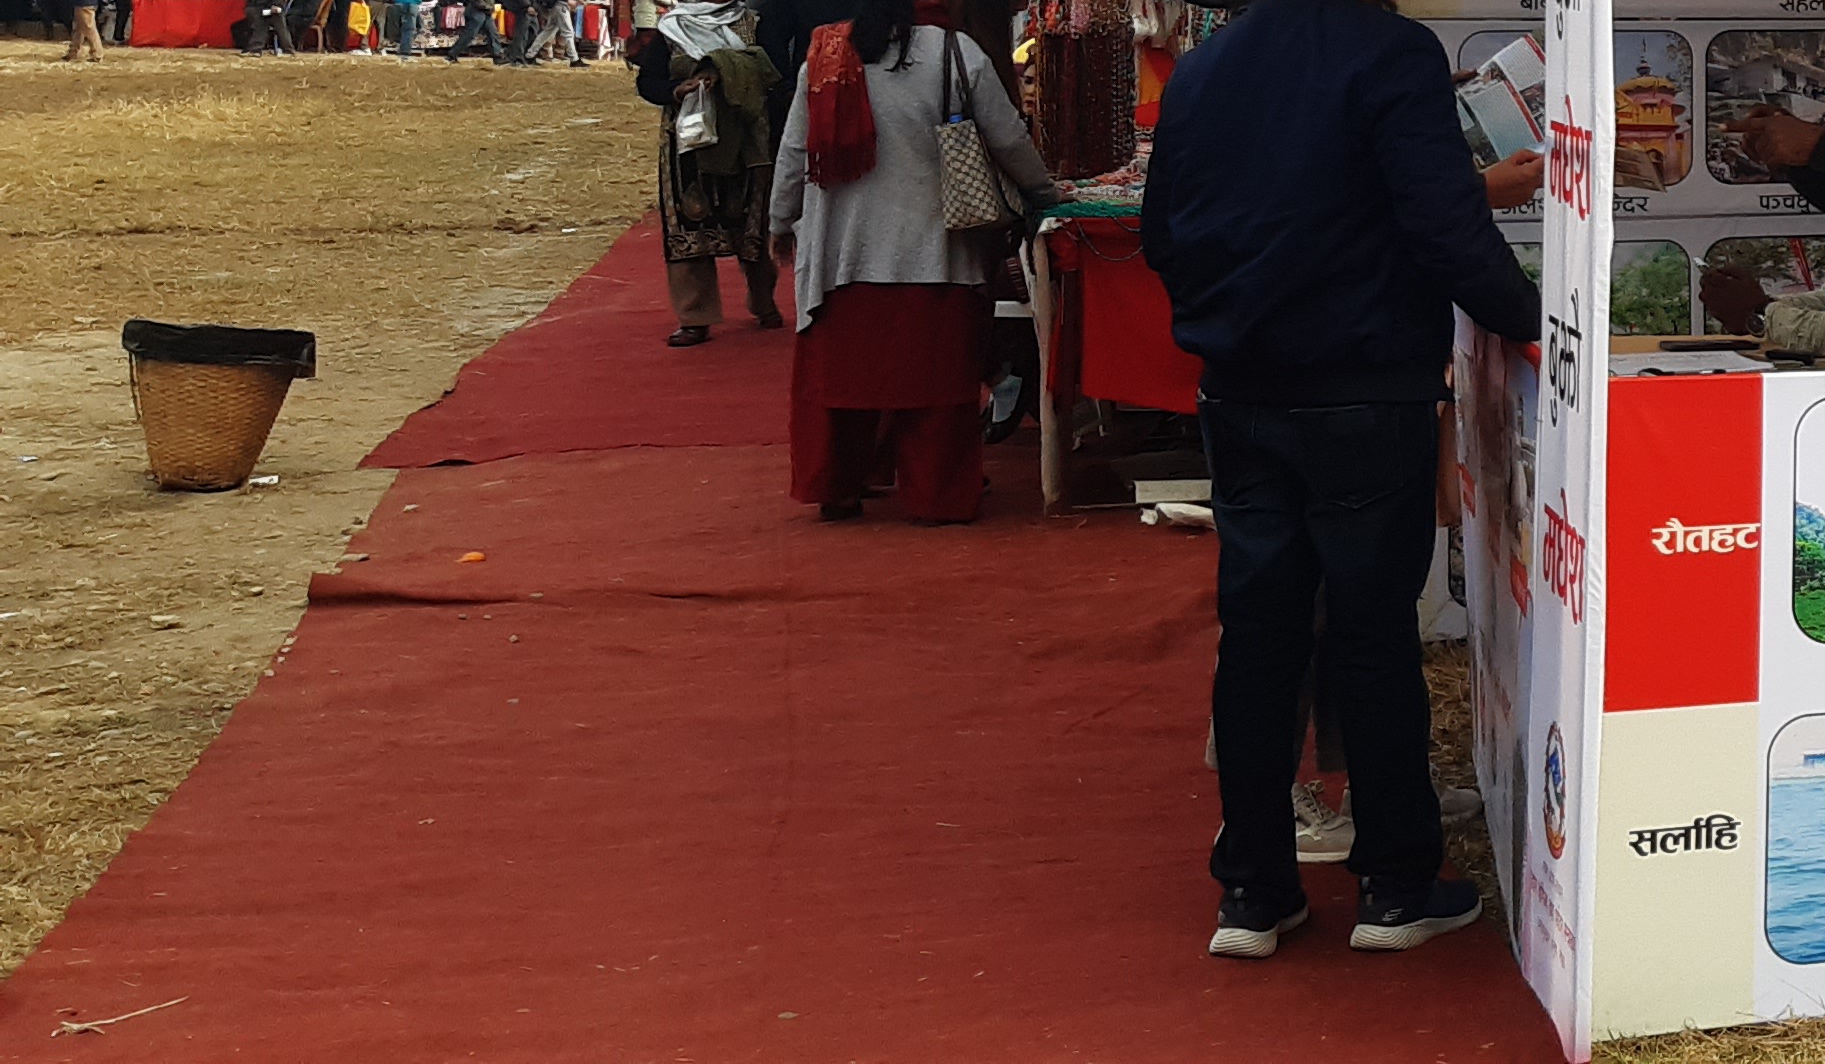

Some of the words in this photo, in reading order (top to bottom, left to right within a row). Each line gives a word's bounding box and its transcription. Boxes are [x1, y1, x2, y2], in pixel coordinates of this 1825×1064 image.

[1550, 93, 1593, 221] मधेश
[1543, 487, 1586, 626] मधेश
[1651, 518, 1761, 555] रौतहट
[1629, 814, 1742, 857] सर्लाहि
